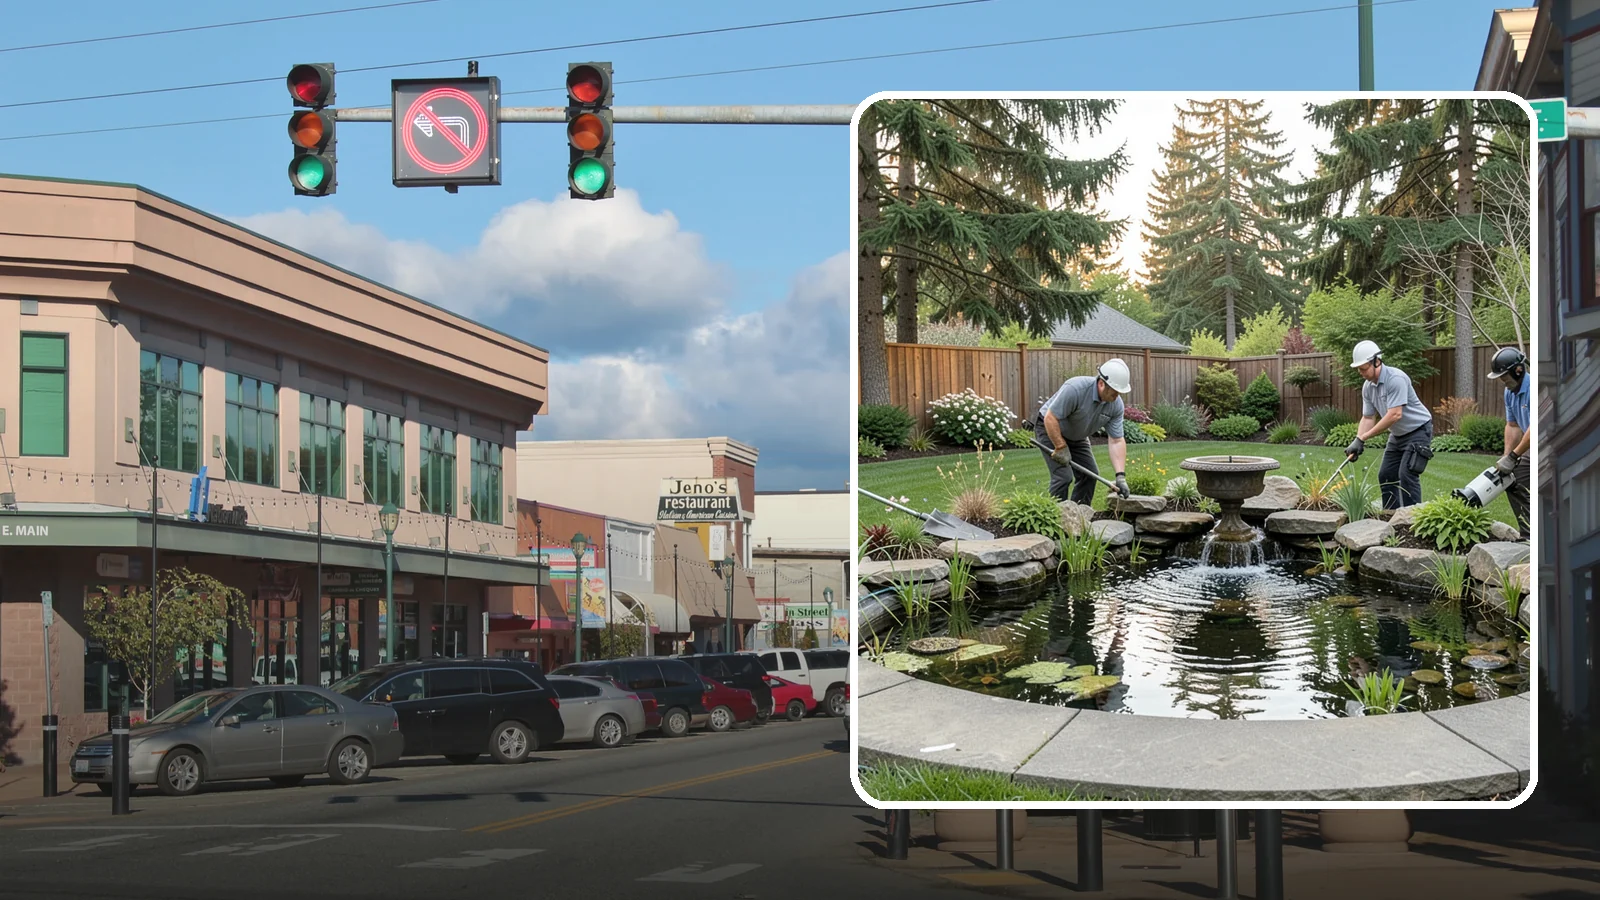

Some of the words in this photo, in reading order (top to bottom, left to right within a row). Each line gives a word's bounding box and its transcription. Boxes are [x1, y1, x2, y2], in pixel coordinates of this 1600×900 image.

[670, 480, 727, 494] Jeno's
[665, 496, 731, 509] restaurant
[659, 509, 681, 519] Italian
[686, 509, 714, 519] American
[715, 509, 737, 519] Cuisine
[2, 525, 13, 536] E.
[15, 525, 49, 536] MAIN
[797, 607, 828, 616] Street
